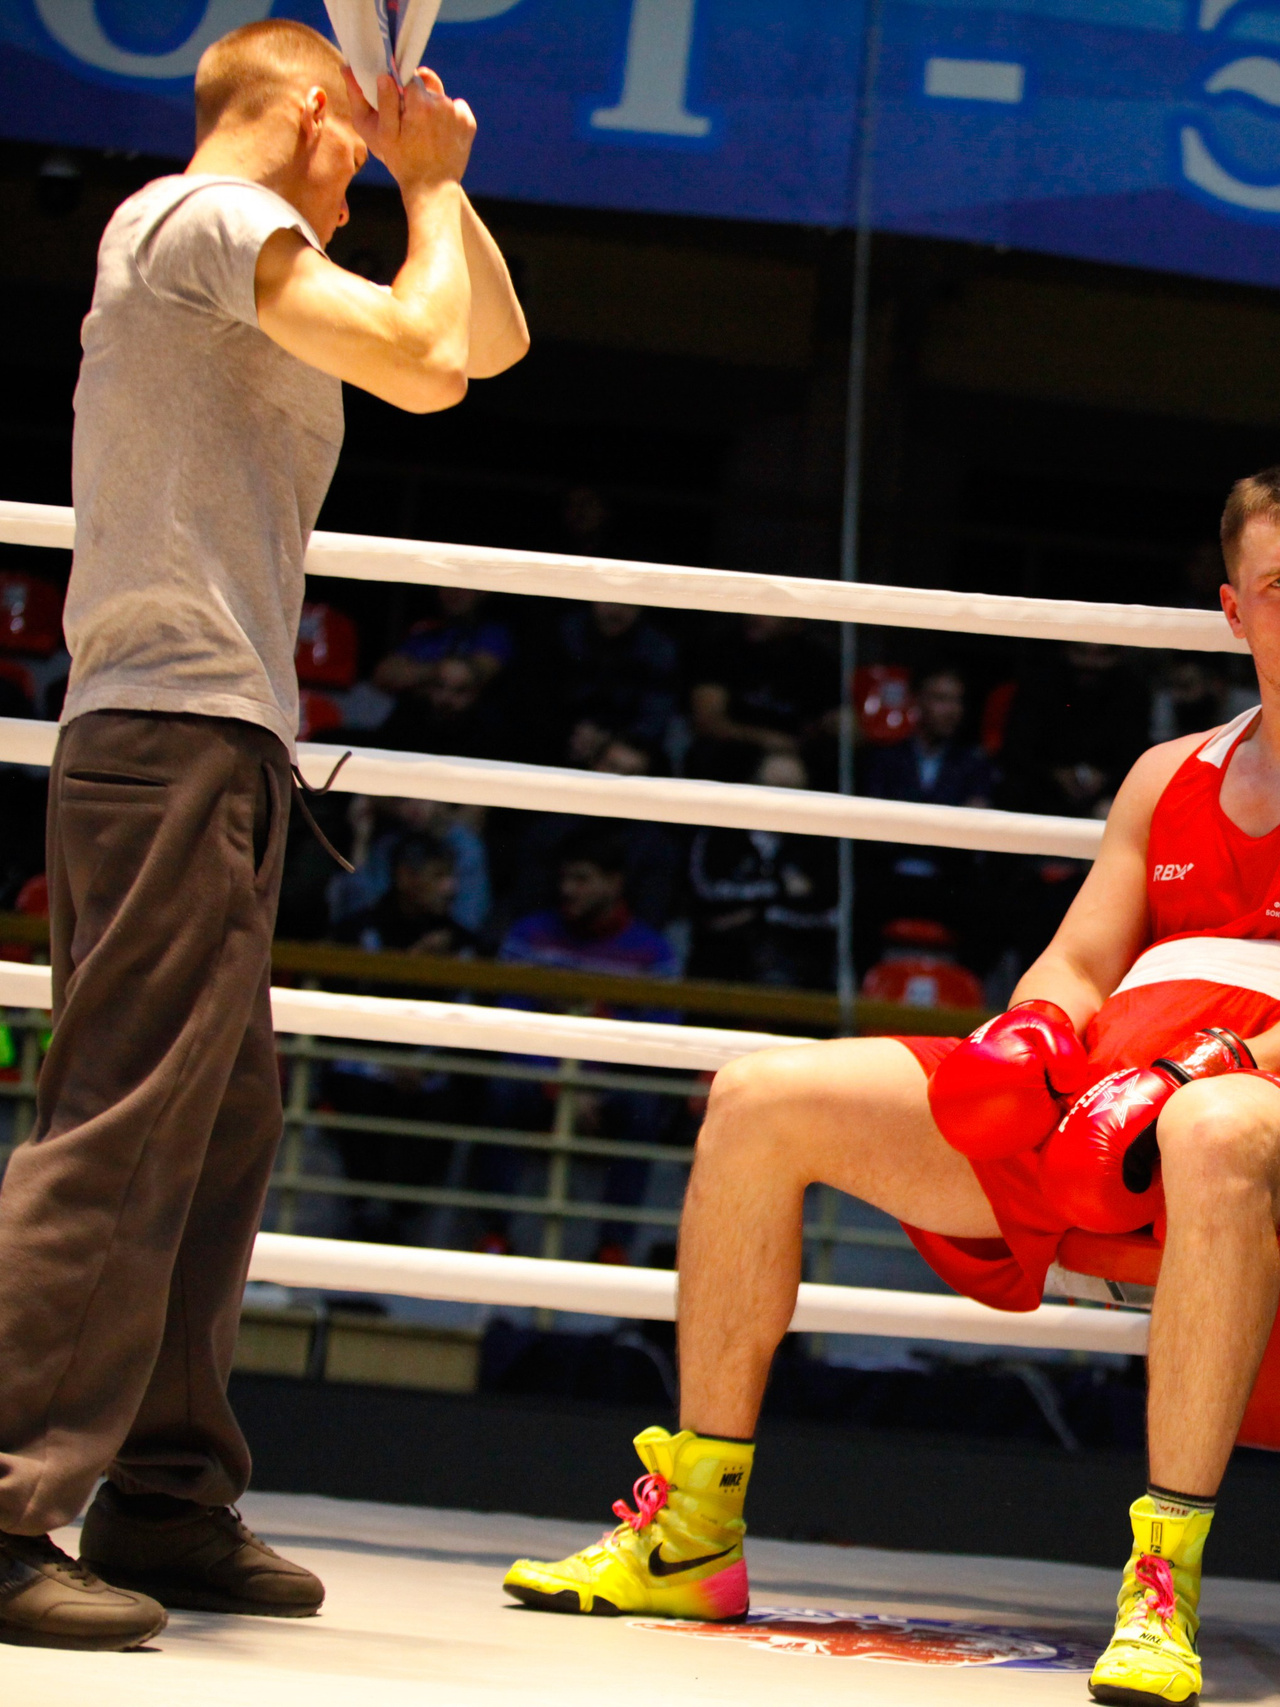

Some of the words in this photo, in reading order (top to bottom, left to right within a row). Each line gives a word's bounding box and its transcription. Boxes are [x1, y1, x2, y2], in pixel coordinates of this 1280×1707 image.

[1153, 863, 1194, 882] RBX
[719, 1472, 744, 1488] NIKE
[1139, 1632, 1161, 1645] NIKE
